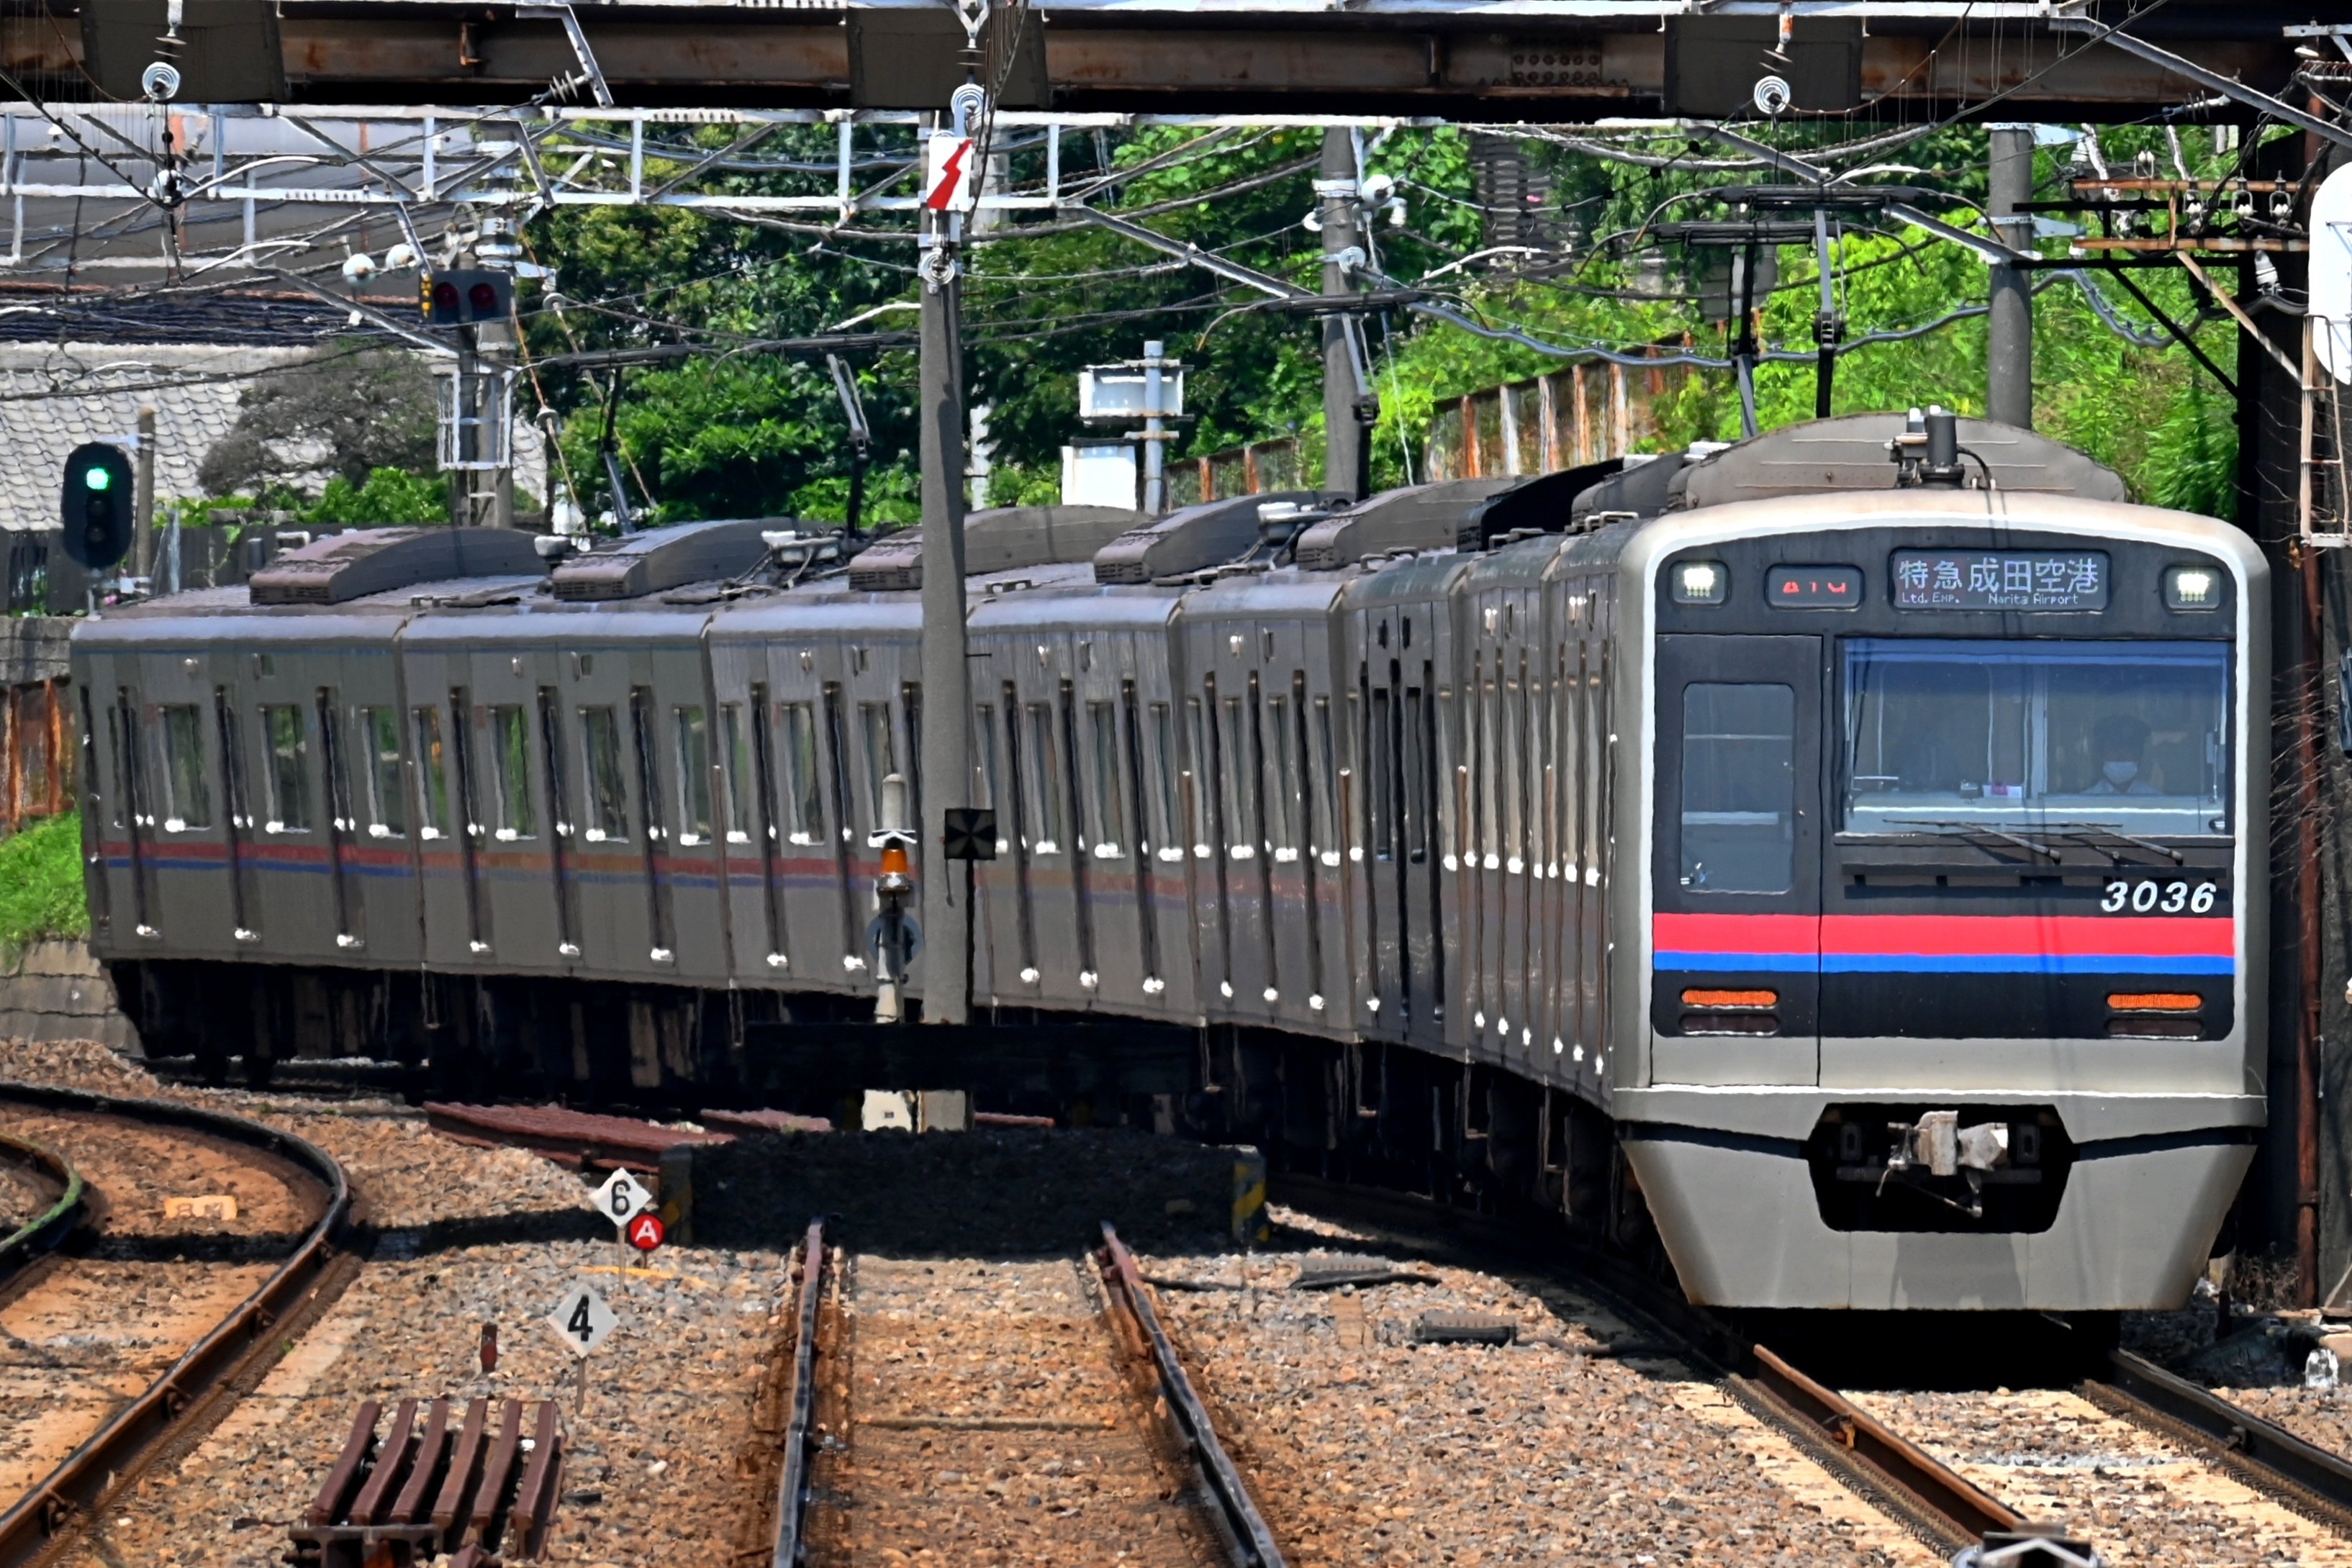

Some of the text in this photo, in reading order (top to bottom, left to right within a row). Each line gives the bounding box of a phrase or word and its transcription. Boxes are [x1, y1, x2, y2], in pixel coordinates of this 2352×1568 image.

[1899, 557, 2099, 594] 特急 成田空港
[1901, 592, 1928, 604] Ltd.
[1988, 593, 2029, 605] Narita
[2033, 592, 2079, 604] Airport
[2101, 880, 2217, 914] 3036
[611, 1179, 630, 1216] 6
[635, 1219, 658, 1243] A
[567, 1294, 594, 1342] 4
